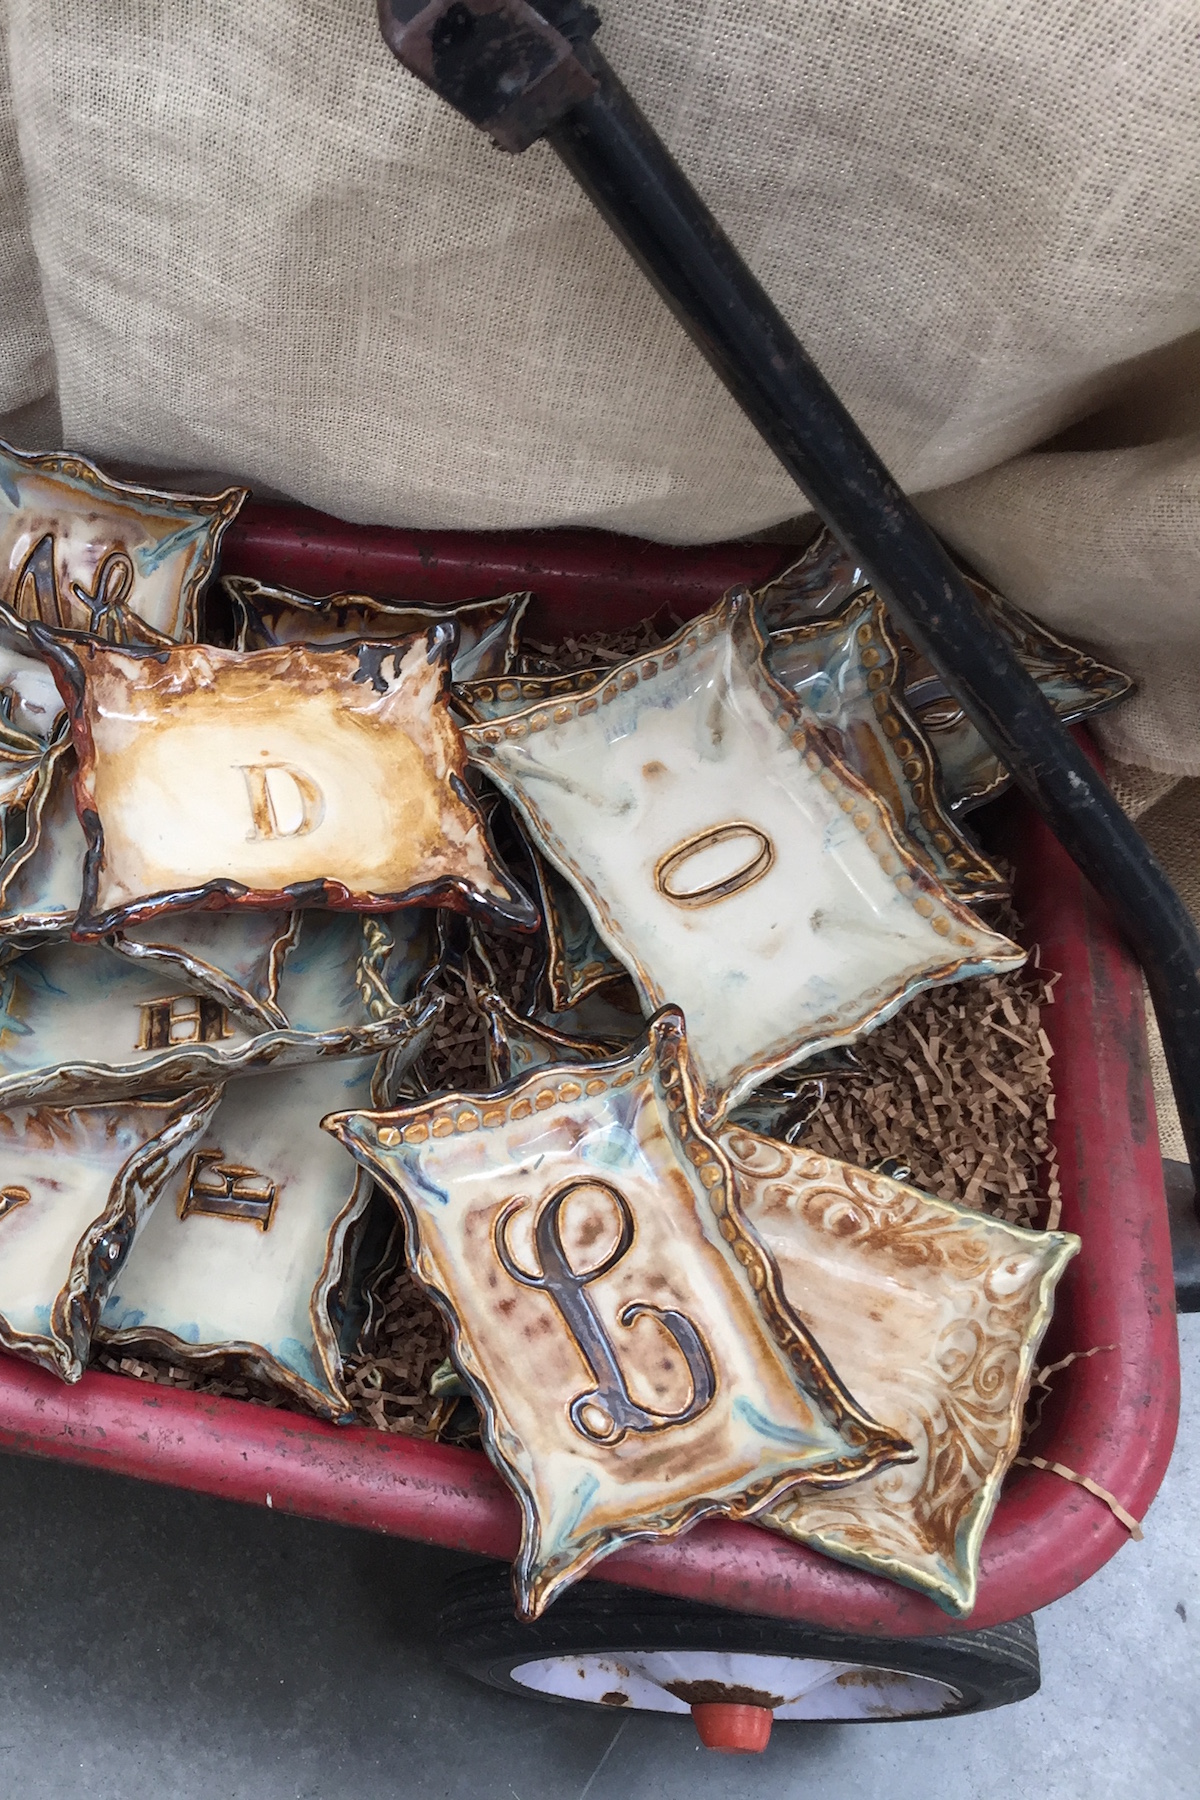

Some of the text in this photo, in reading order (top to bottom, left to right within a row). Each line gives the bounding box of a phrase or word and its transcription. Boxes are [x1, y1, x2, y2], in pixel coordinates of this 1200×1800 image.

[229, 758, 326, 845] D
[654, 821, 778, 910] O
[132, 993, 235, 1052] H
